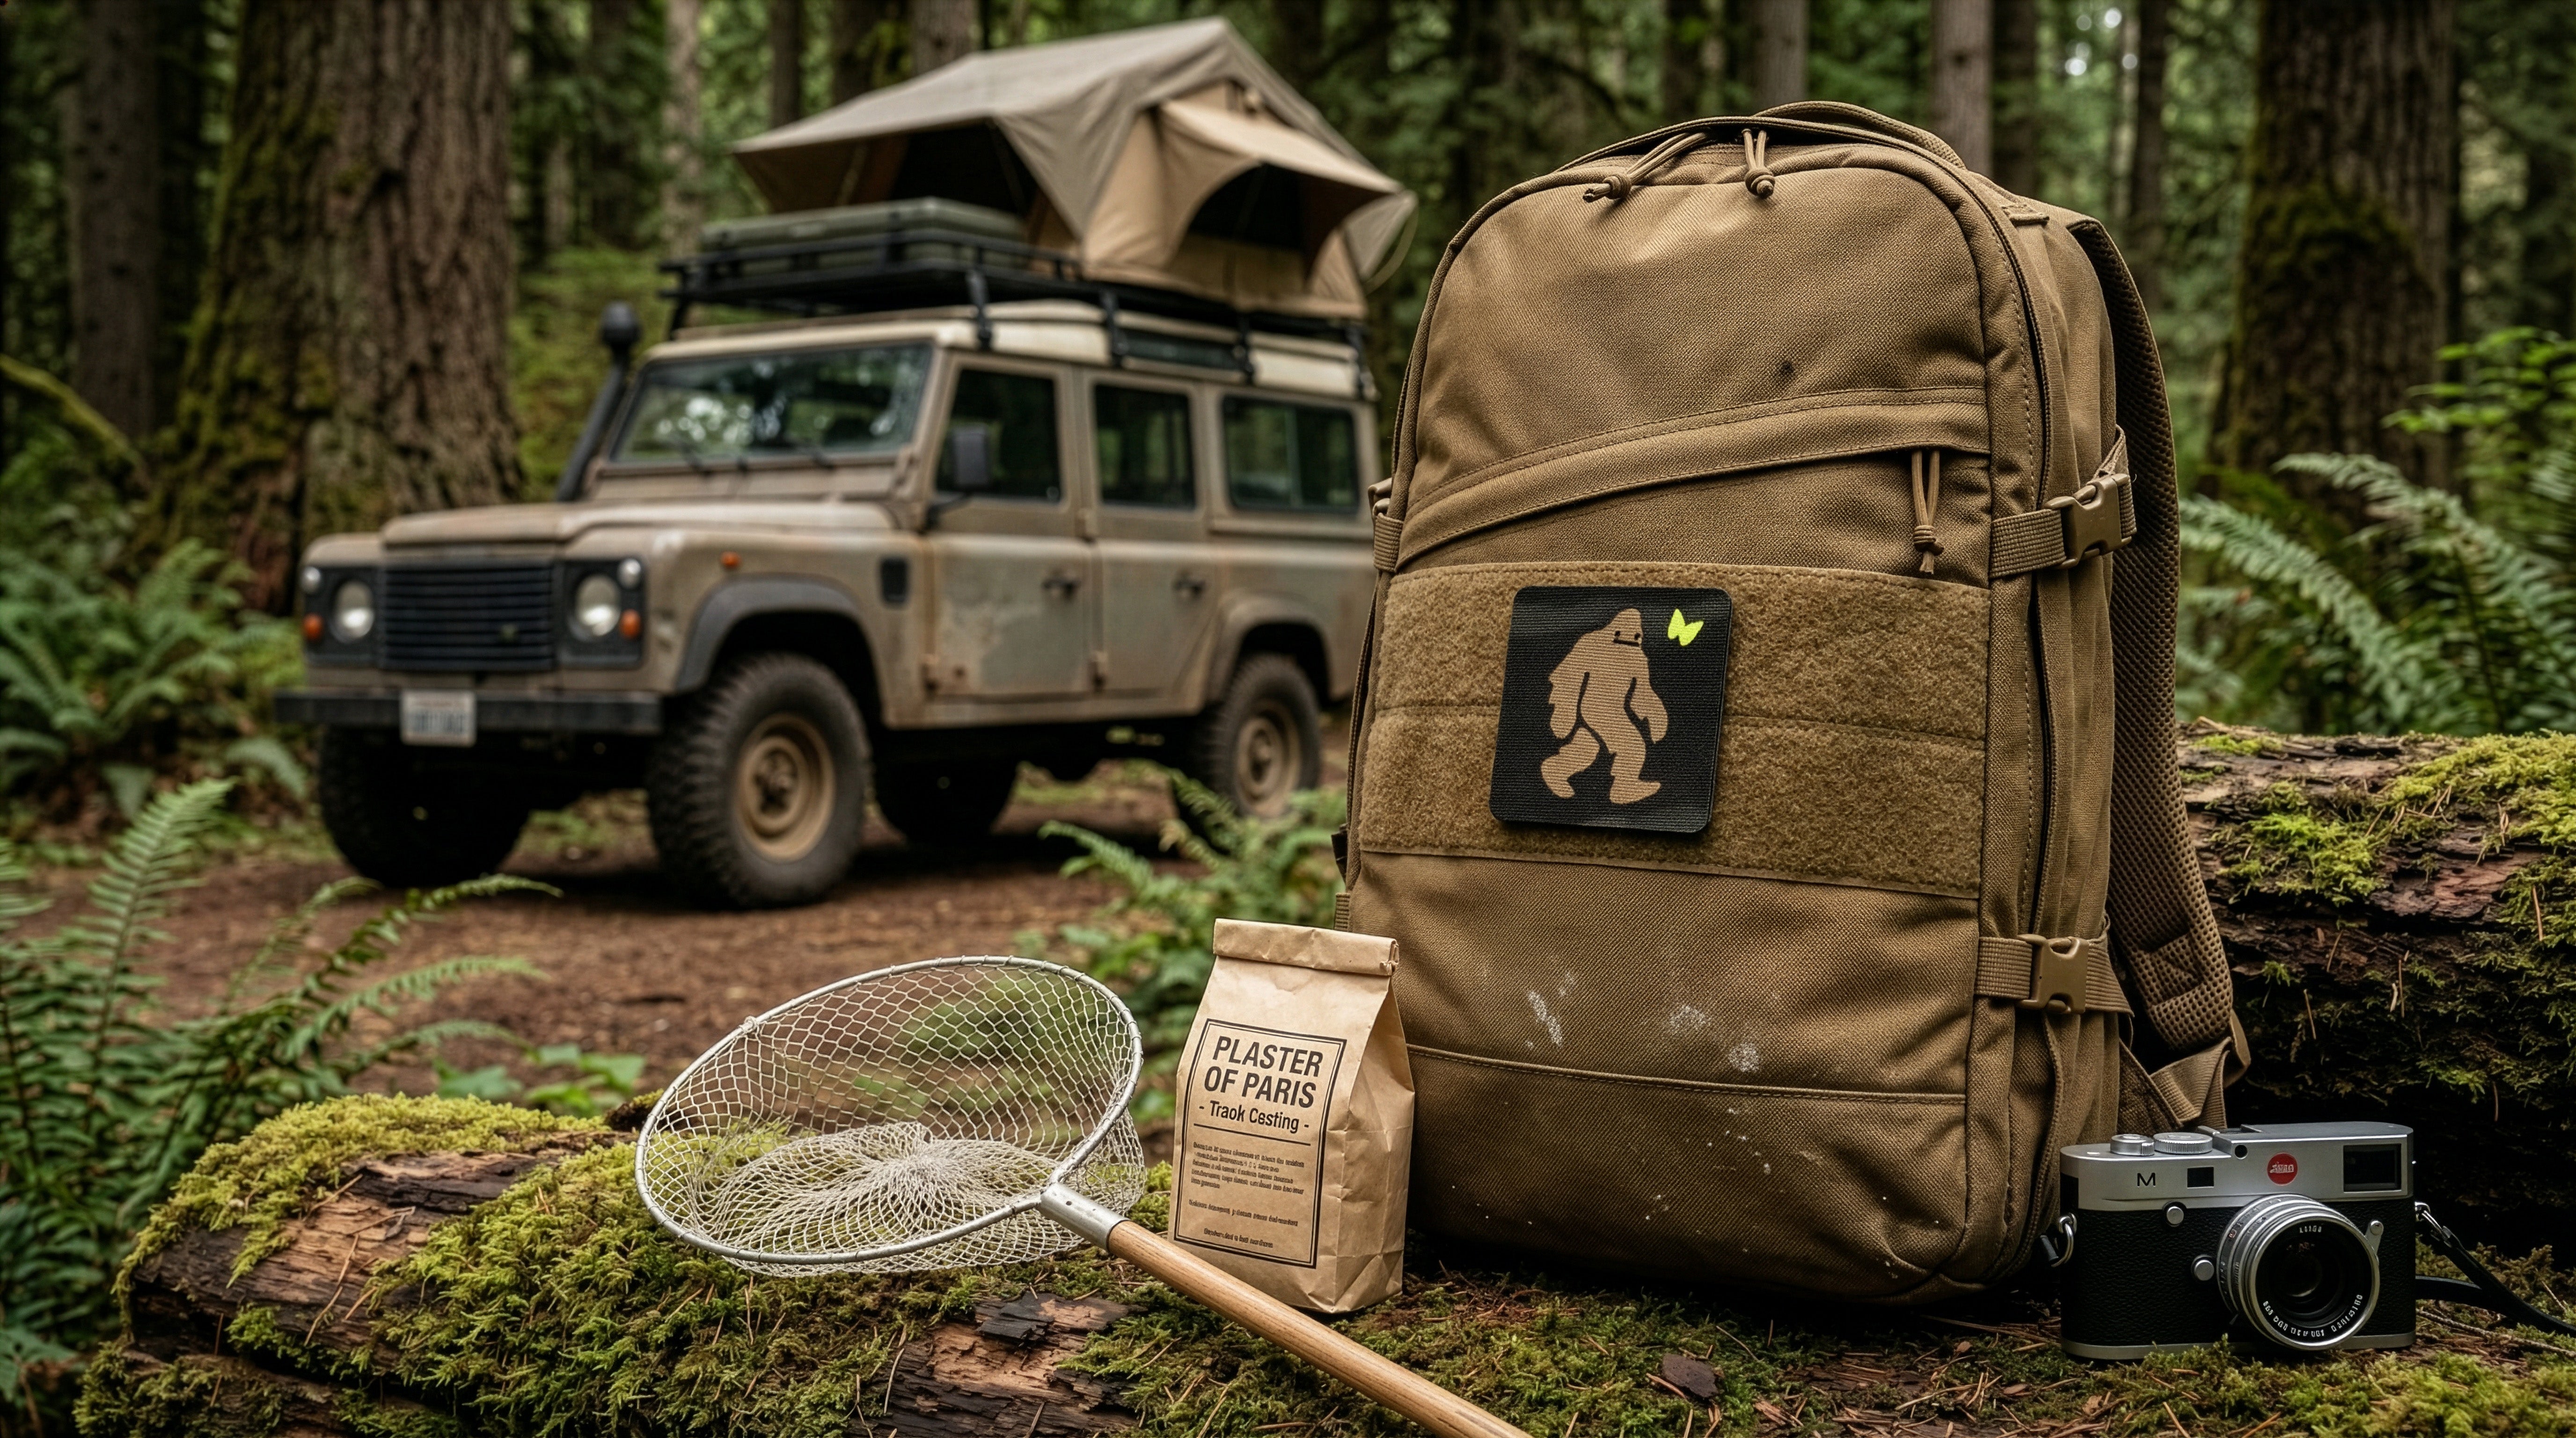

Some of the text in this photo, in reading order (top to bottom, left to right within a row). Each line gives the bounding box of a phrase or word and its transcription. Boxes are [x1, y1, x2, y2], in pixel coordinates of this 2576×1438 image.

[1212, 1035, 1323, 1077] PLASTER
[1204, 1066, 1317, 1108] OF PARIS
[2137, 1172, 2156, 1187] M
